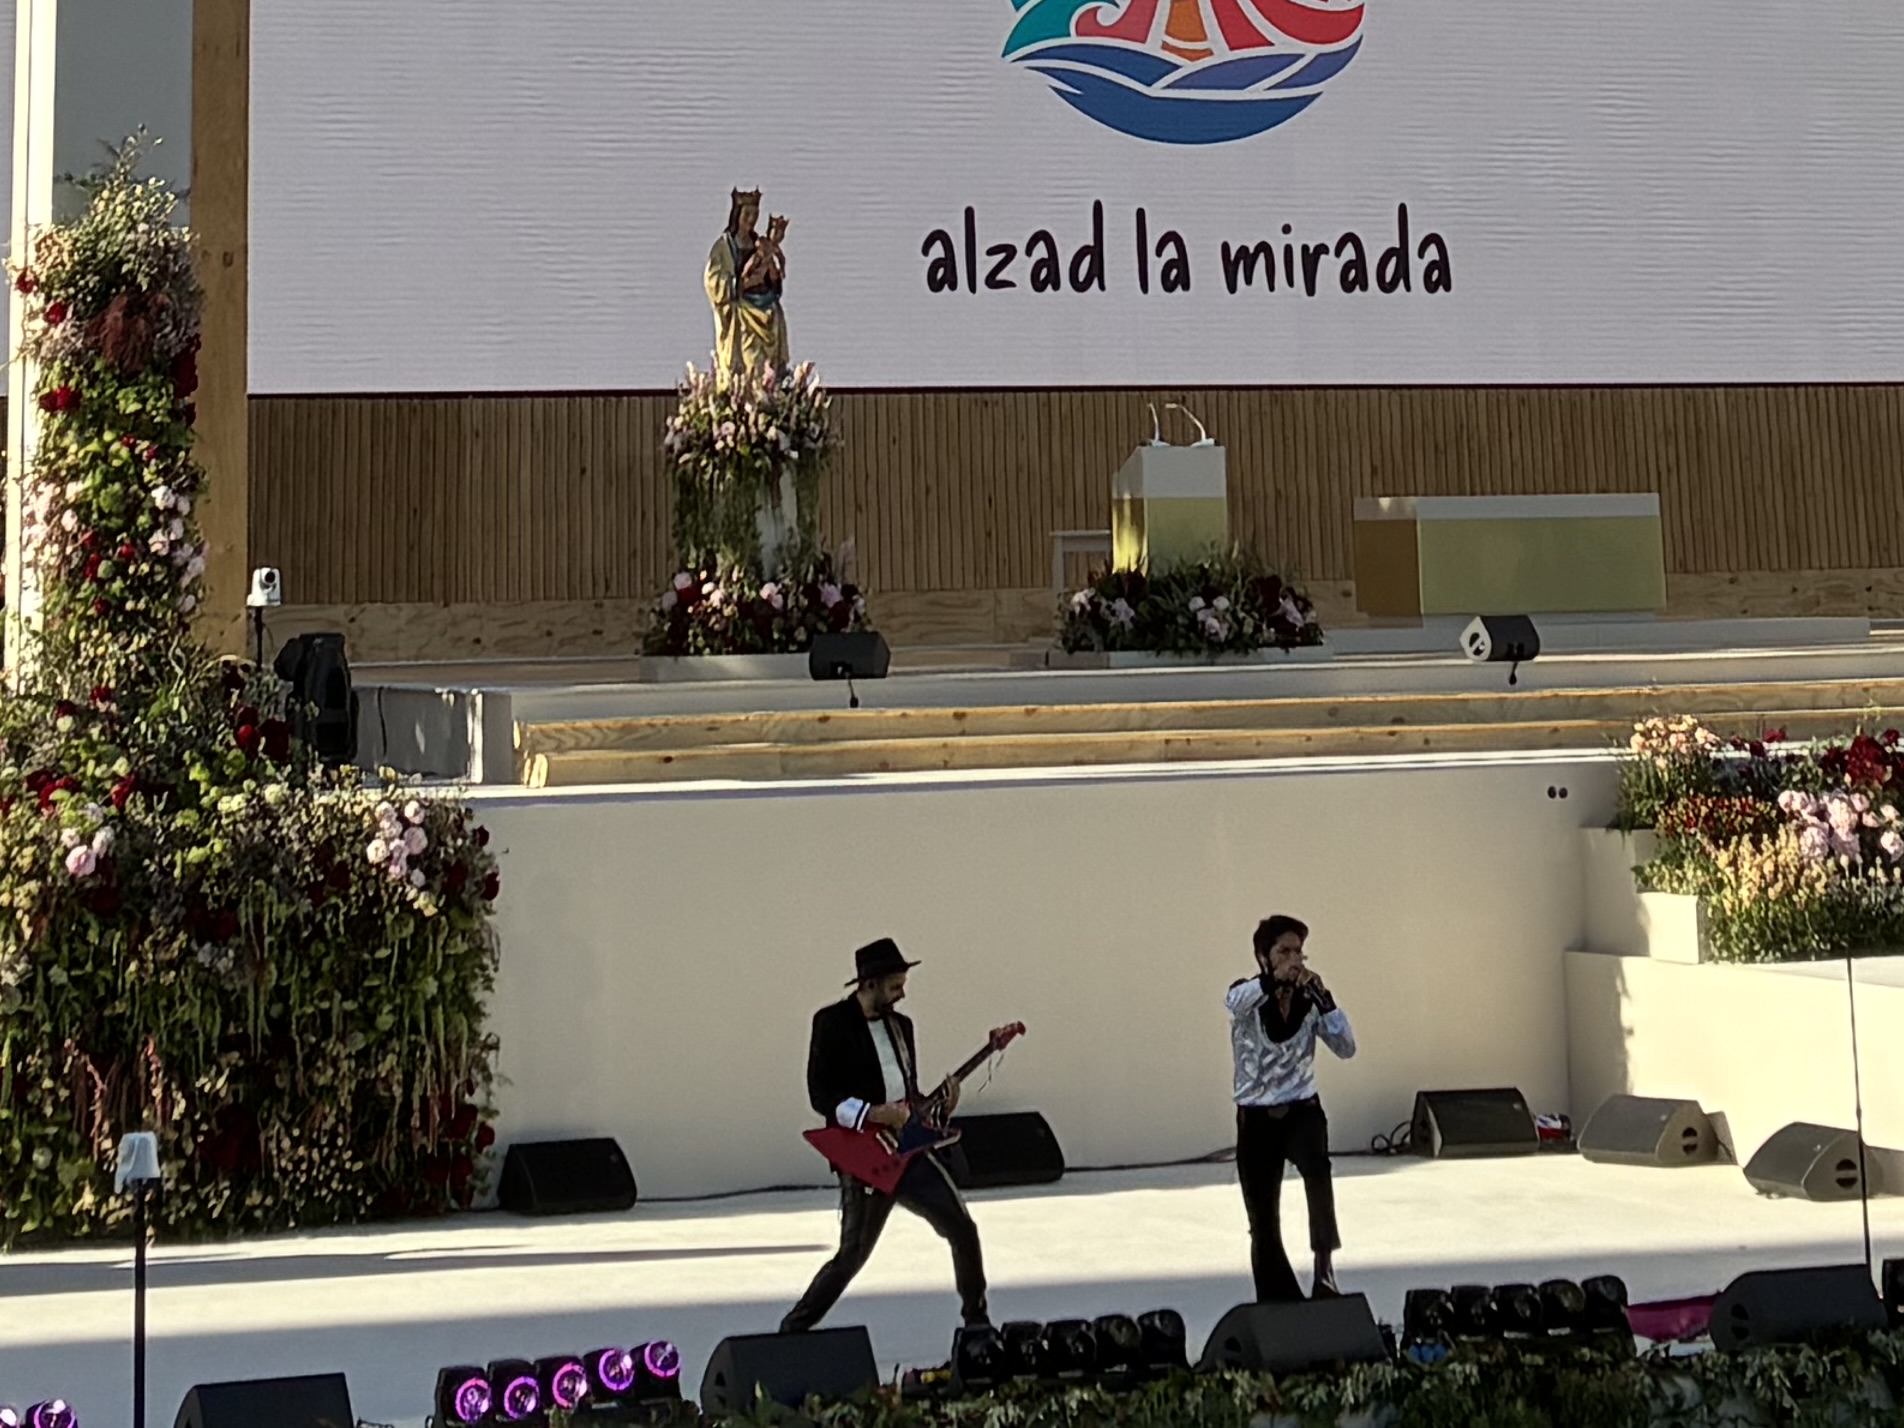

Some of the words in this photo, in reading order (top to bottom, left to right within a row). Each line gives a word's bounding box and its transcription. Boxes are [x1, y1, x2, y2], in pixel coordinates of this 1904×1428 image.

[921, 199, 1107, 295] alzad
[1135, 207, 1192, 295] la
[1220, 202, 1453, 298] mirada
